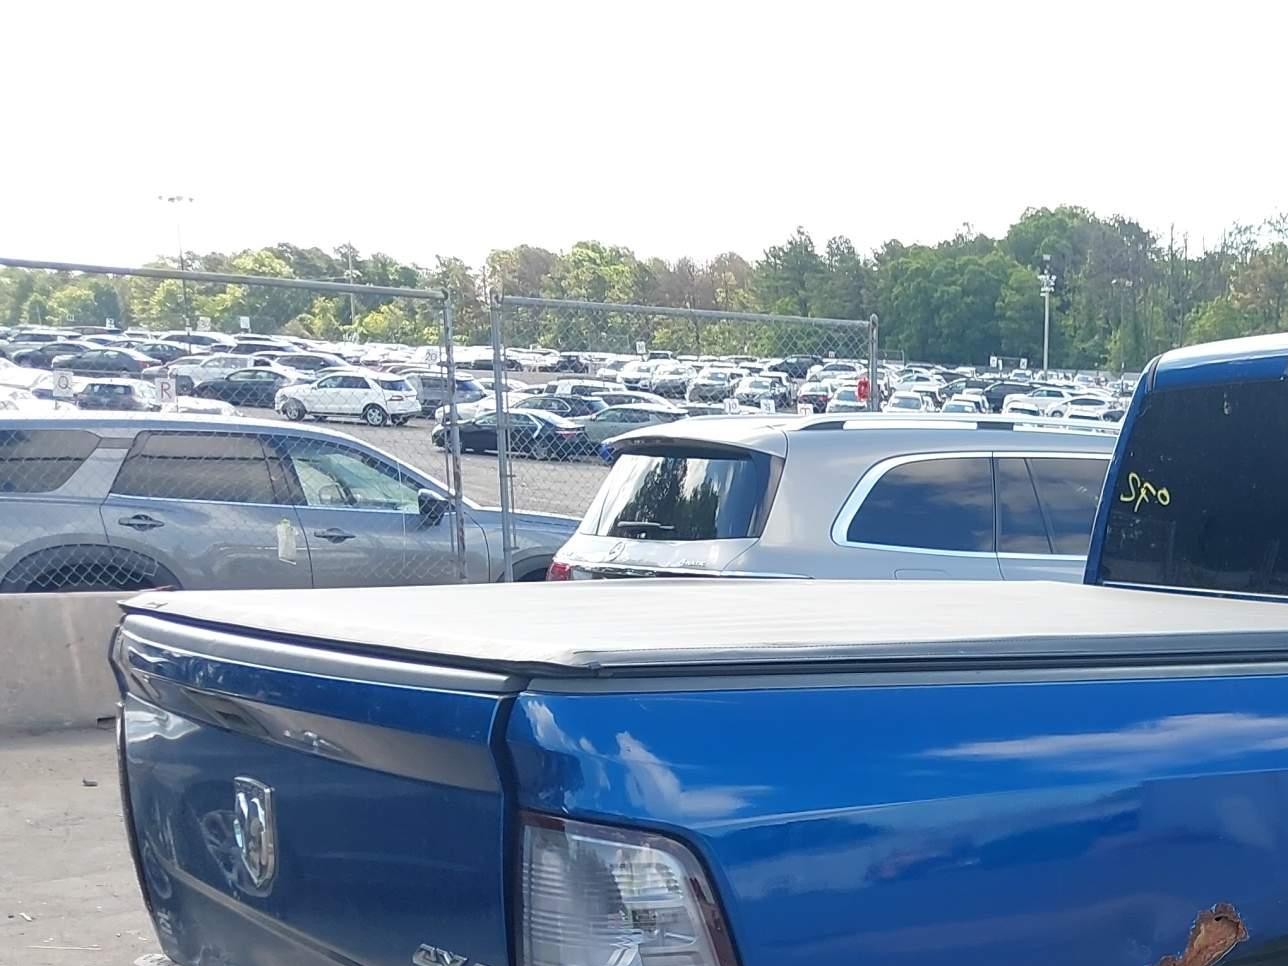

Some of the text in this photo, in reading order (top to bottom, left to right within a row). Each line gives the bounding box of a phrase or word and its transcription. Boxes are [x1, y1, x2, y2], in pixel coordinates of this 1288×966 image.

[425, 351, 437, 362] 20
[58, 376, 71, 390] Q
[160, 382, 171, 398] R
